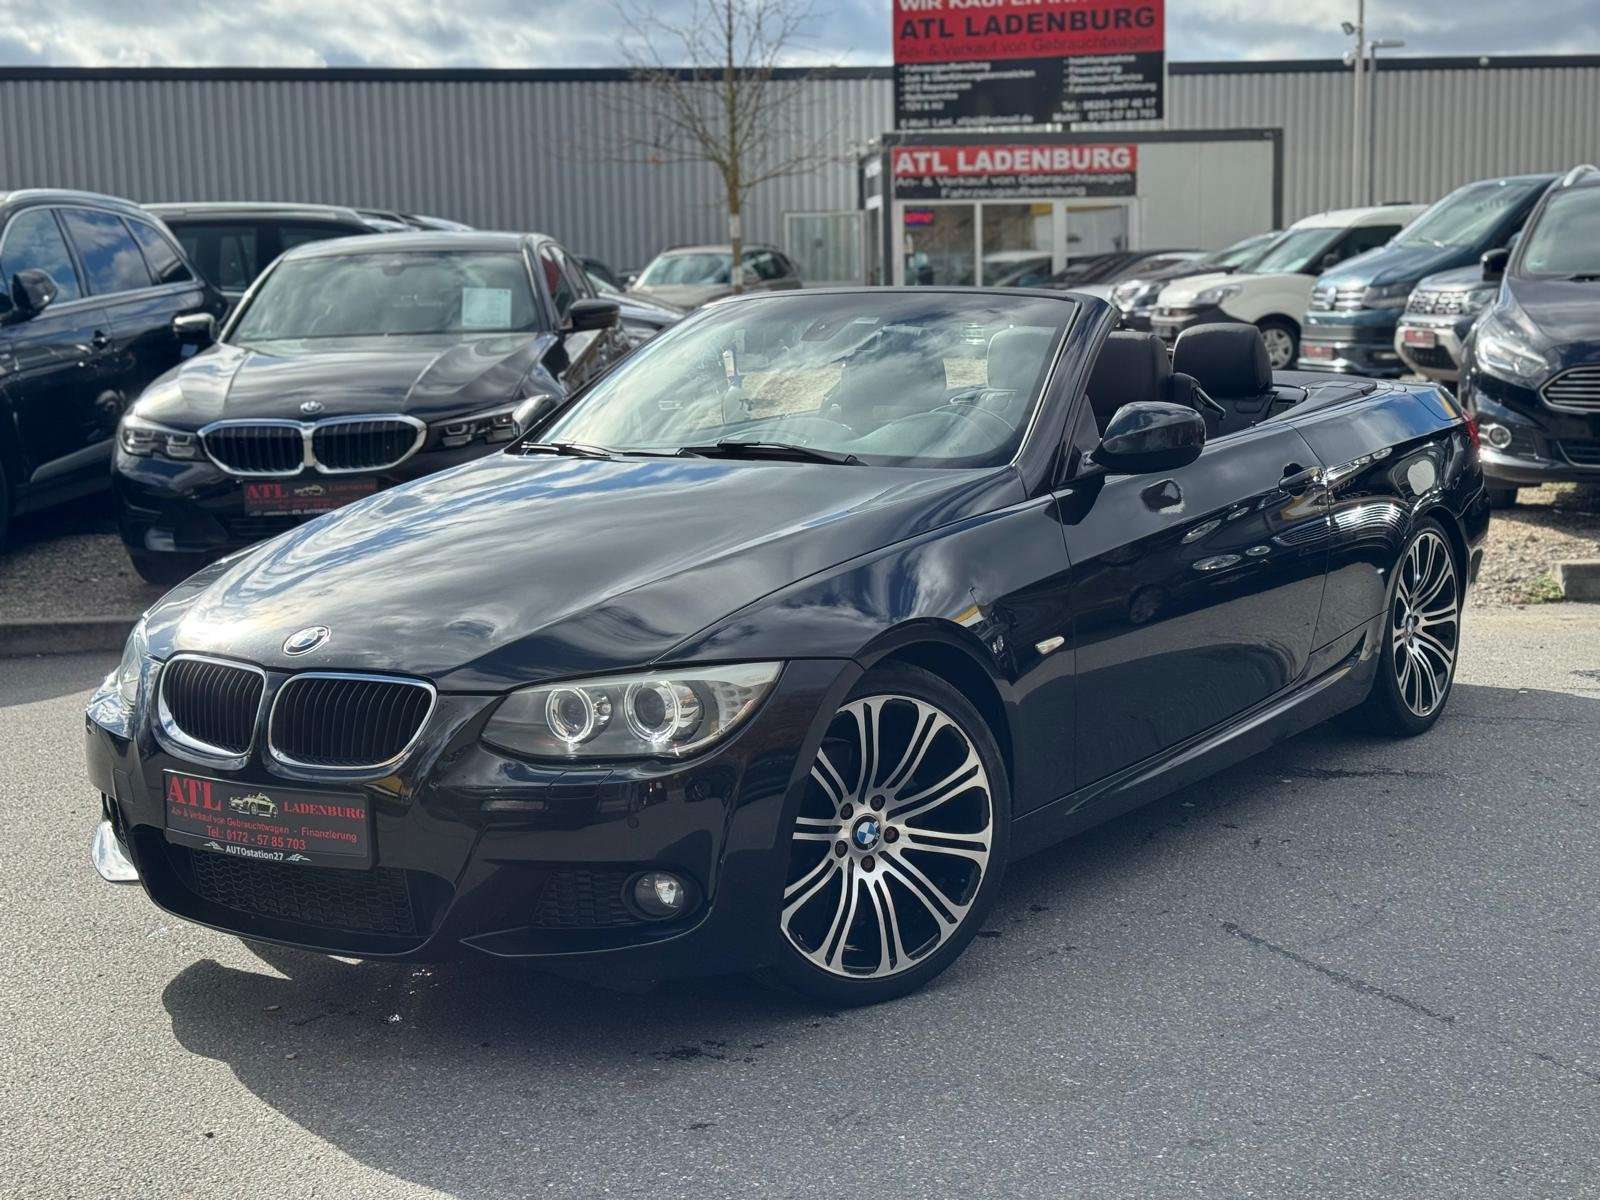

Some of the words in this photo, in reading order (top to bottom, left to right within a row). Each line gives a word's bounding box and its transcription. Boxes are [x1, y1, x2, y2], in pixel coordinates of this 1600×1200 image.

[900, 18, 954, 40] ATL
[965, 8, 1154, 36] LADENBURG
[896, 152, 948, 173] ATL
[957, 148, 1131, 171] LADENBURG
[937, 175, 987, 187] Verkauf
[991, 176, 1015, 185] von
[1018, 173, 1131, 185] Gebrauchtwagen
[247, 481, 286, 498] ATL
[168, 776, 223, 811] ATL
[283, 801, 366, 820] LADENBURG
[227, 817, 290, 834] Gebrauchtwagen
[301, 826, 358, 843] Finanzierung
[227, 830, 248, 843] 0172
[256, 834, 269, 846] 57
[287, 838, 306, 850] 703
[226, 845, 284, 861] AUTOstation27
